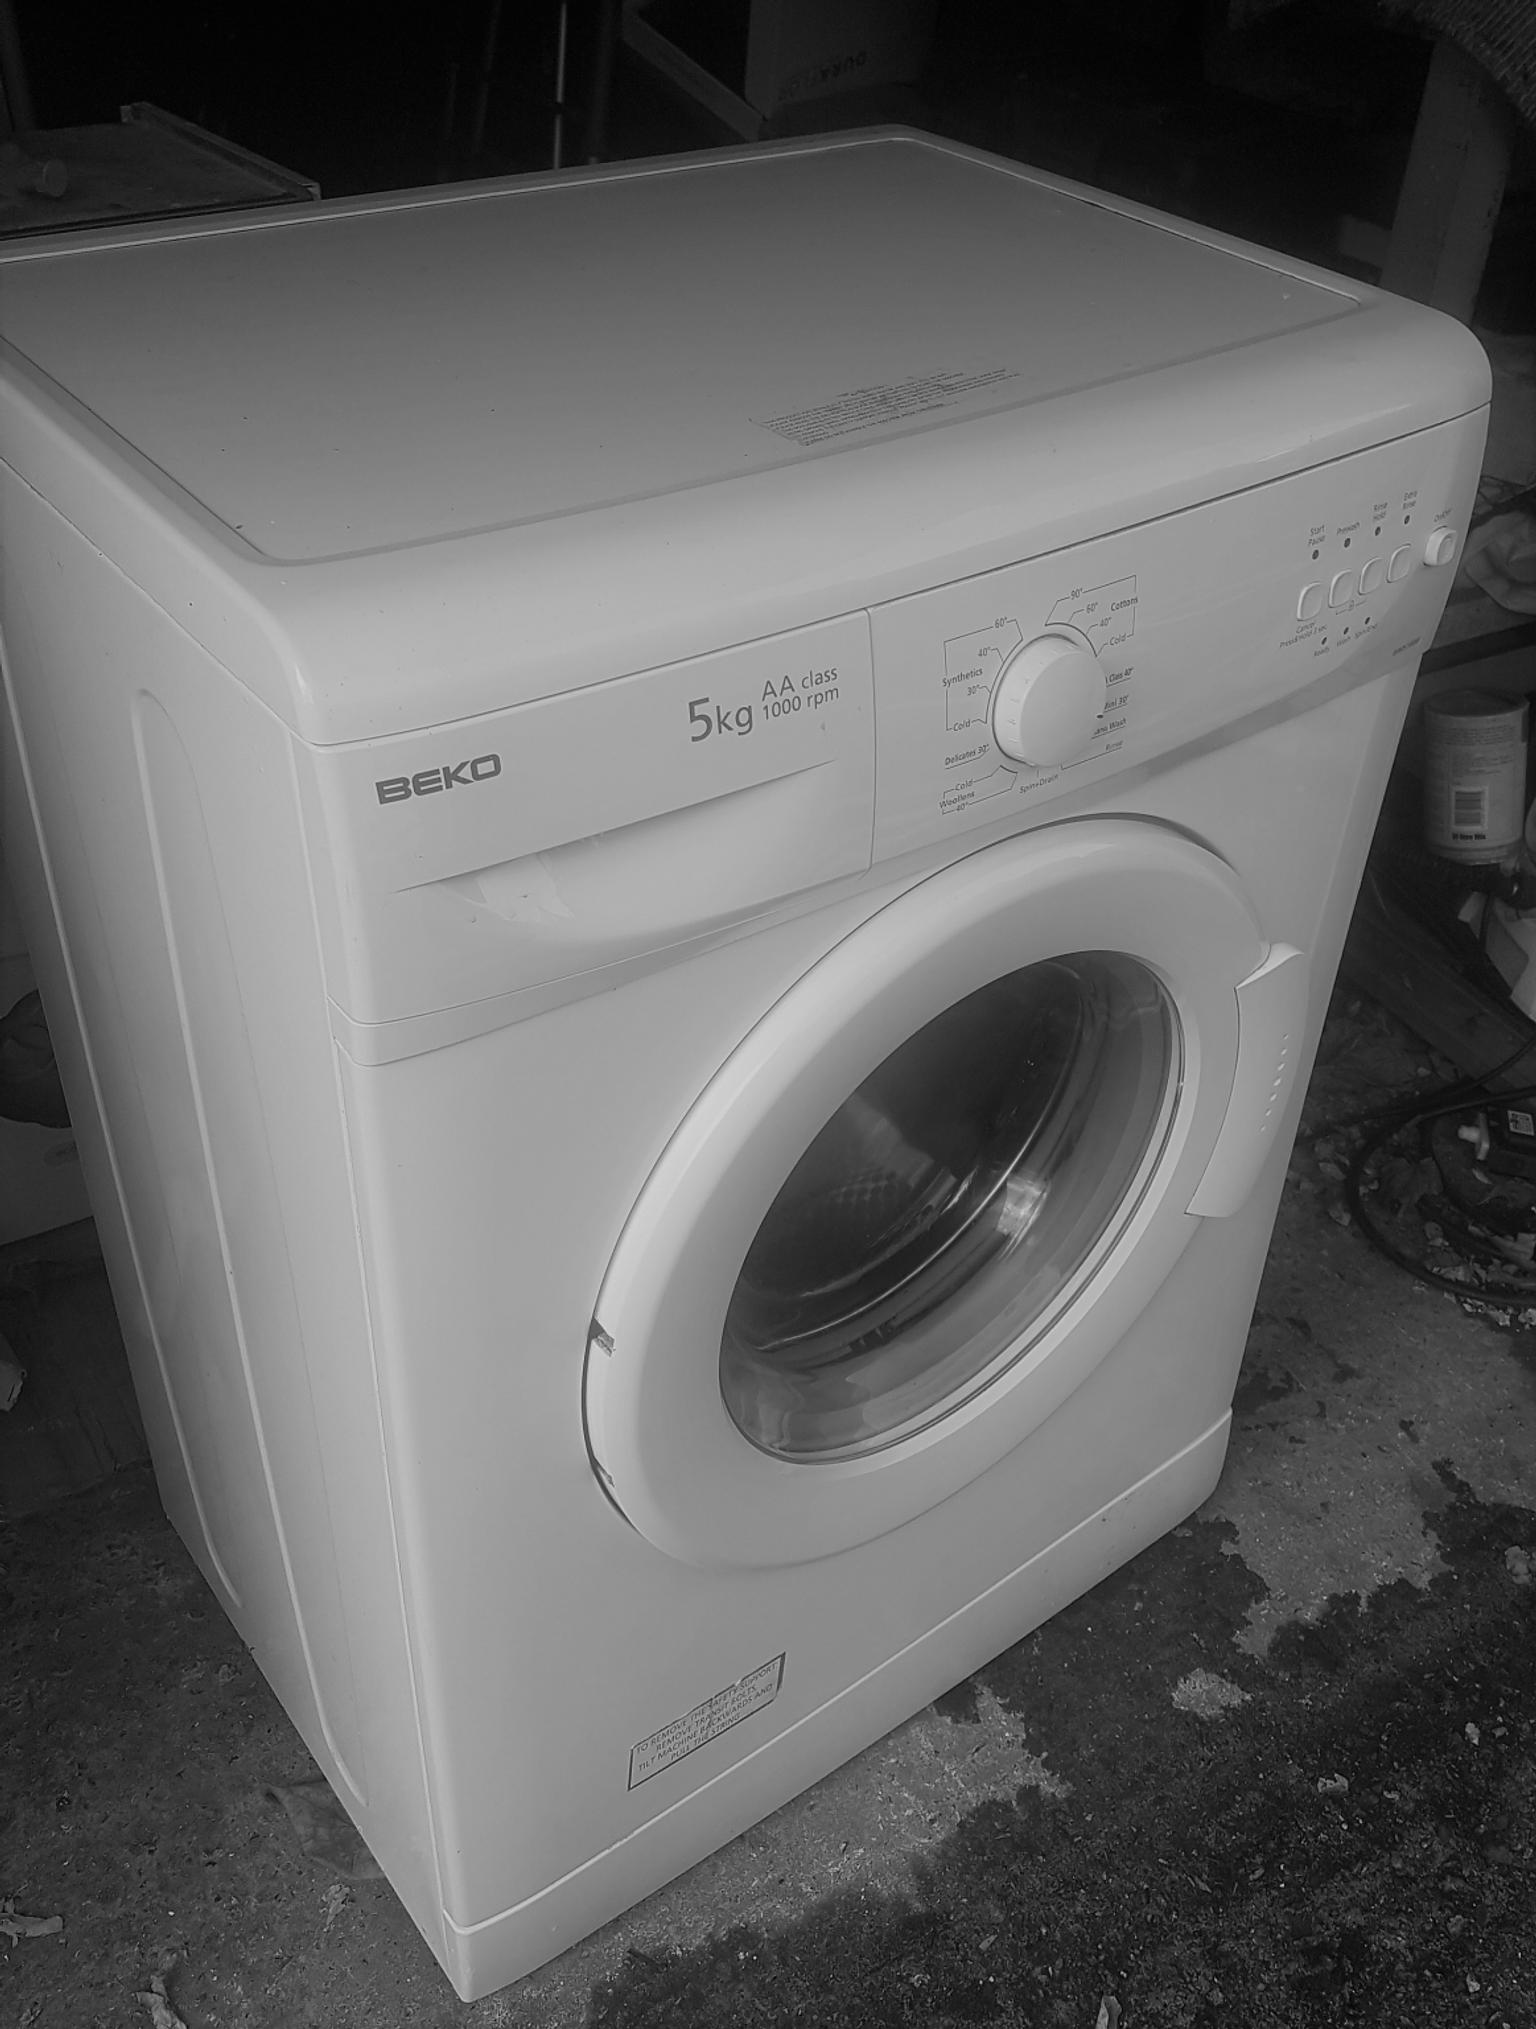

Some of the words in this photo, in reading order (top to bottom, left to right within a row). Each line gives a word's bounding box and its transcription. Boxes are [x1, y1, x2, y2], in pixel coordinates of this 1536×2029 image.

[994, 617, 1007, 629] 60°
[801, 667, 838, 689] class
[942, 668, 983, 687] Synthetics
[762, 695, 801, 720] 1000
[807, 687, 839, 710] rpm
[953, 719, 971, 732] Cold
[944, 750, 976, 766] Delicates
[375, 754, 502, 804] BEKO
[955, 779, 974, 791] Cold
[657, 1730, 697, 1760] MACHINE
[753, 1682, 773, 1700] AND
[637, 1743, 649, 1754] TO
[651, 1719, 687, 1744] REMOVE
[656, 1724, 691, 1751] REMOVE
